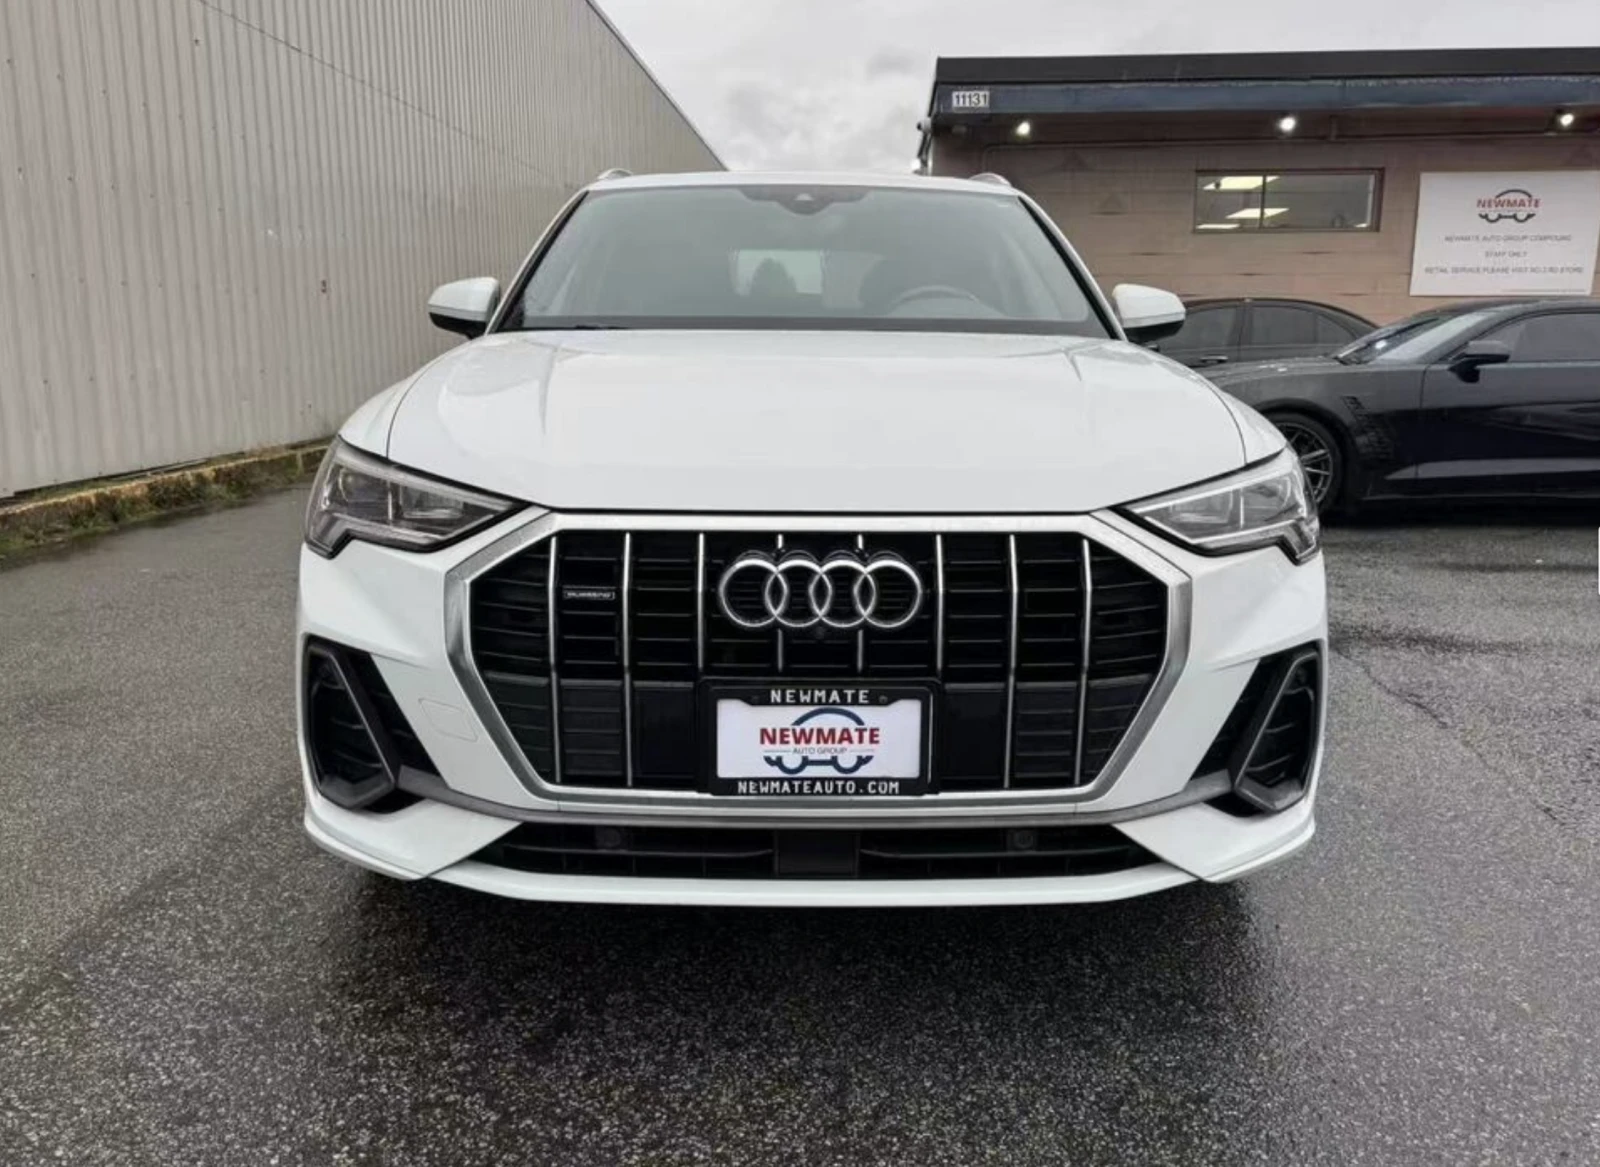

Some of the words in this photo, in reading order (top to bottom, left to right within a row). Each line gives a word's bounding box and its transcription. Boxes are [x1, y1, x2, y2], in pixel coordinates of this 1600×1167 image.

[954, 92, 988, 106] 11131
[1477, 198, 1541, 208] NEWMATE
[770, 689, 870, 704] NEWMATE
[759, 727, 880, 745] NEWMATE
[737, 780, 899, 794] NEWMATEAUTO.COM
